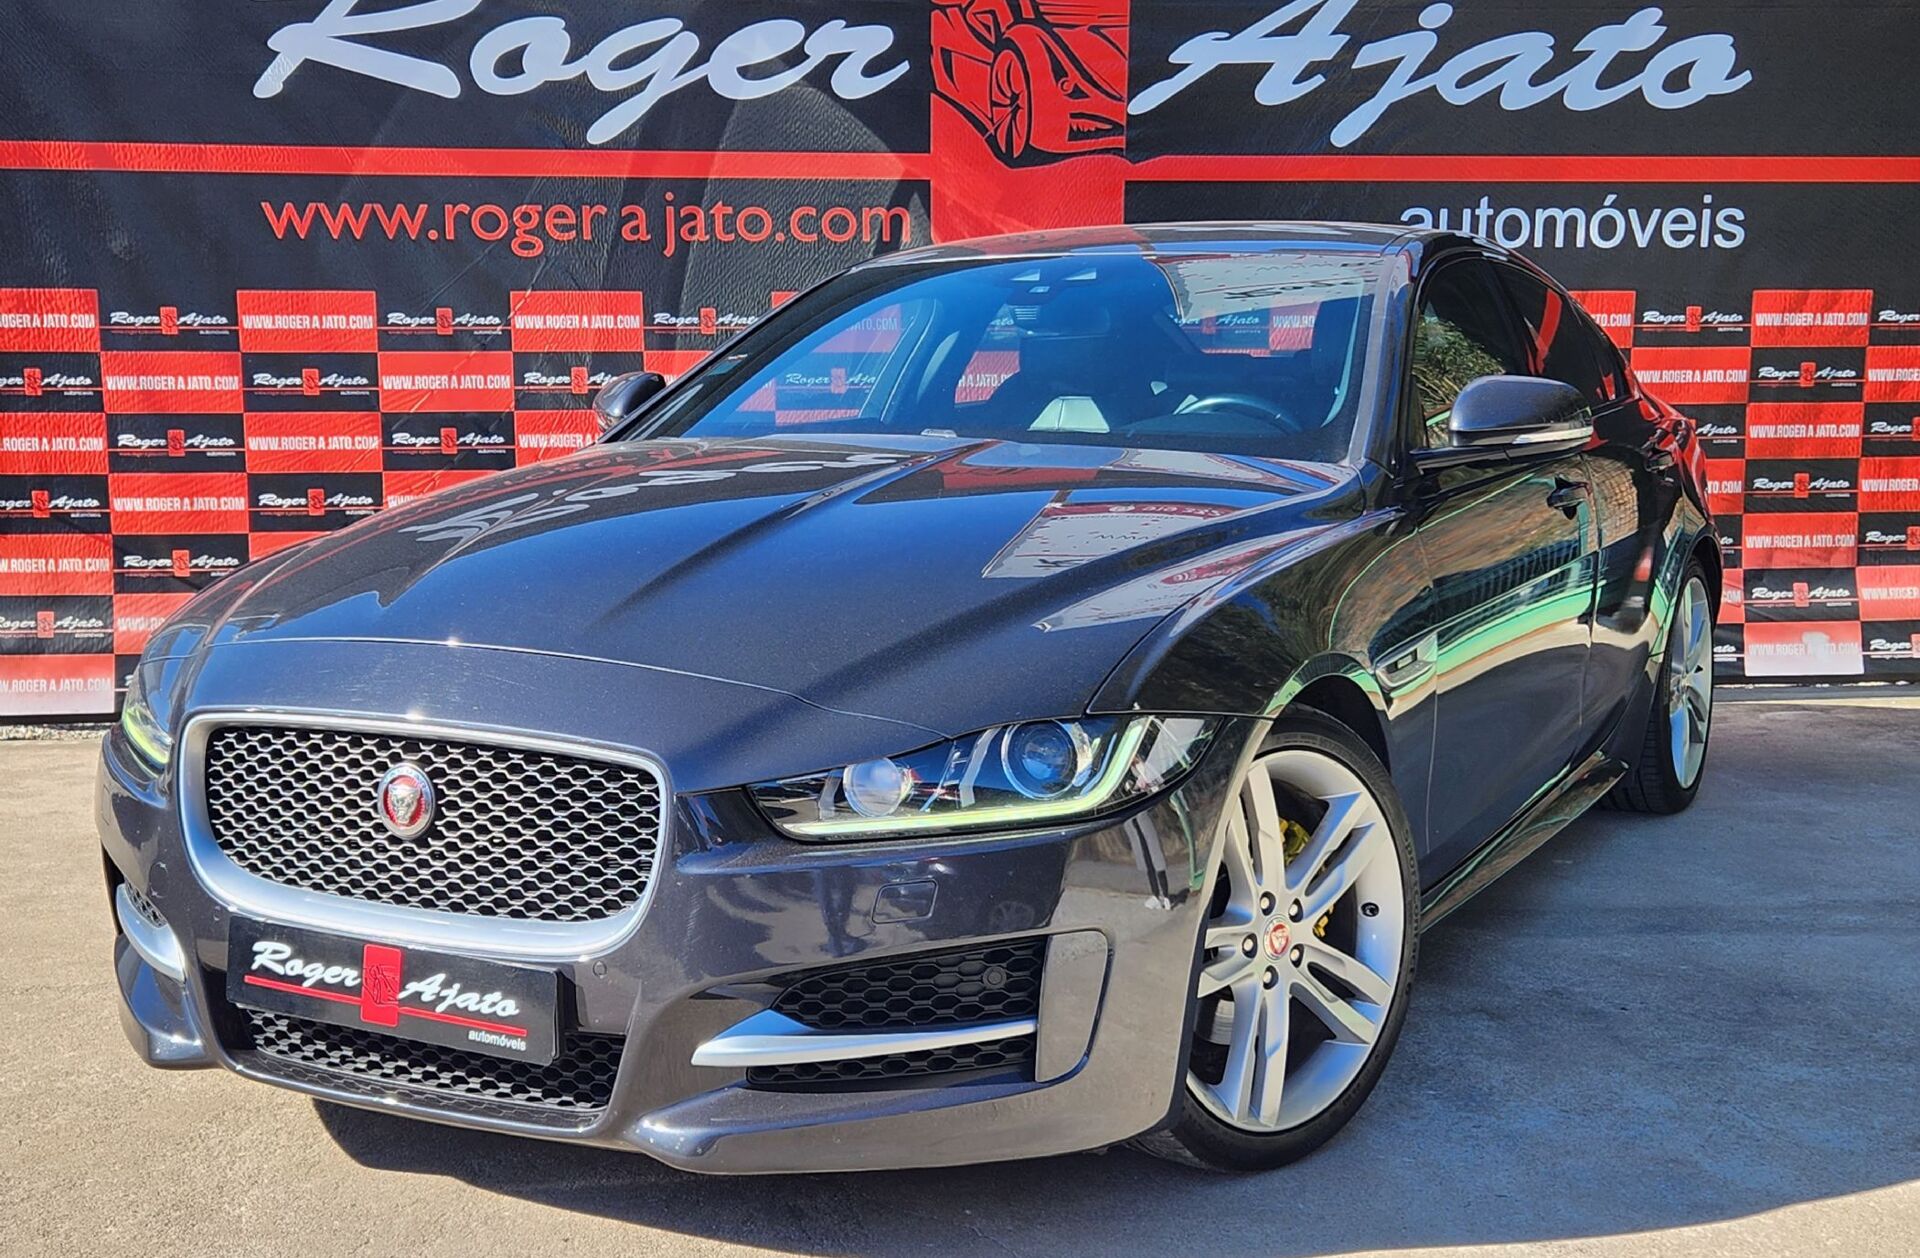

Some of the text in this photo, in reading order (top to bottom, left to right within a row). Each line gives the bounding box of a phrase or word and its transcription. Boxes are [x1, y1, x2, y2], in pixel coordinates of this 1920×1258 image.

[252, 0, 1754, 148] Roger Ajato
[260, 192, 911, 257] www.roger a jato.com
[43, 313, 96, 328] JATO.COM
[110, 311, 229, 327] Roger Ajato
[242, 314, 374, 330] WWW.ROGER A JATO.COM
[387, 312, 502, 328] Roger Ajato
[514, 314, 640, 329] WWW.ROGER A JATO.COM
[653, 312, 758, 327] Roger Ajat
[1642, 310, 1744, 325] Roger Ajato
[1755, 312, 1868, 327] WWW.ROGER A JATO.COM
[41, 373, 93, 388] Ajato
[252, 373, 369, 389] Roger Ajato
[523, 372, 571, 387] Roger
[786, 373, 831, 388] Roger
[1702, 369, 1747, 383] JATO.COM
[1758, 366, 1857, 381] Roger Ajato
[106, 375, 239, 391] WWW.ROGER A JATO.COM
[382, 374, 511, 391] WWW.ROGER A JATO.COM
[1695, 423, 1738, 437] Ajato
[1749, 424, 1860, 439] WWW.ROGER A JATO.COM
[1870, 421, 1912, 436] Roger
[51, 437, 104, 452] JATO.COM
[117, 433, 236, 450] Roger Ajato
[249, 436, 379, 450] WWW.ROGER A JATO.COM
[391, 432, 505, 449] Roger Ajato
[1752, 477, 1850, 493] Roger Ajato
[48, 495, 100, 511] Ajato
[113, 496, 245, 512] WWW.ROGER A JATO.COM
[258, 492, 308, 509] Roger
[324, 493, 374, 508] Ajato
[1811, 535, 1856, 548] JATO.COM
[1865, 530, 1907, 546] Roger
[57, 557, 111, 573] JATO.COM
[123, 555, 240, 571] Roger Ajato
[1752, 586, 1794, 601] Roger
[1807, 586, 1851, 600] Ajato
[53, 615, 105, 632] Ajato
[1869, 638, 1912, 653] Roger
[58, 678, 112, 694] JATO.COM
[251, 941, 520, 1018] Roger Ajato
[468, 1028, 527, 1052] automóveis
